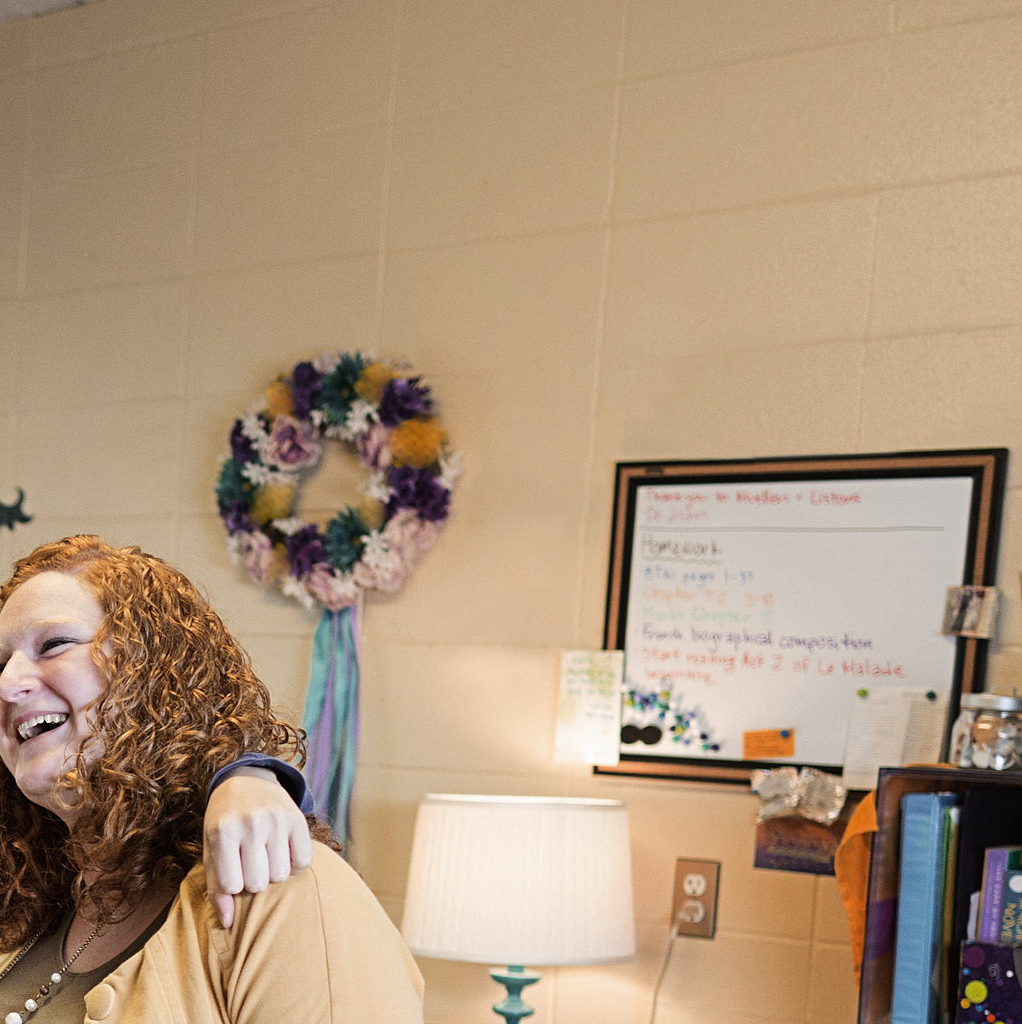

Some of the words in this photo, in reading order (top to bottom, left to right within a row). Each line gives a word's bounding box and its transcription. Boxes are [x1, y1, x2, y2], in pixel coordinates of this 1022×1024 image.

[690, 625, 774, 653] biographical
[778, 633, 873, 654] composition
[793, 655, 810, 674] of
[842, 657, 906, 679] Malade
